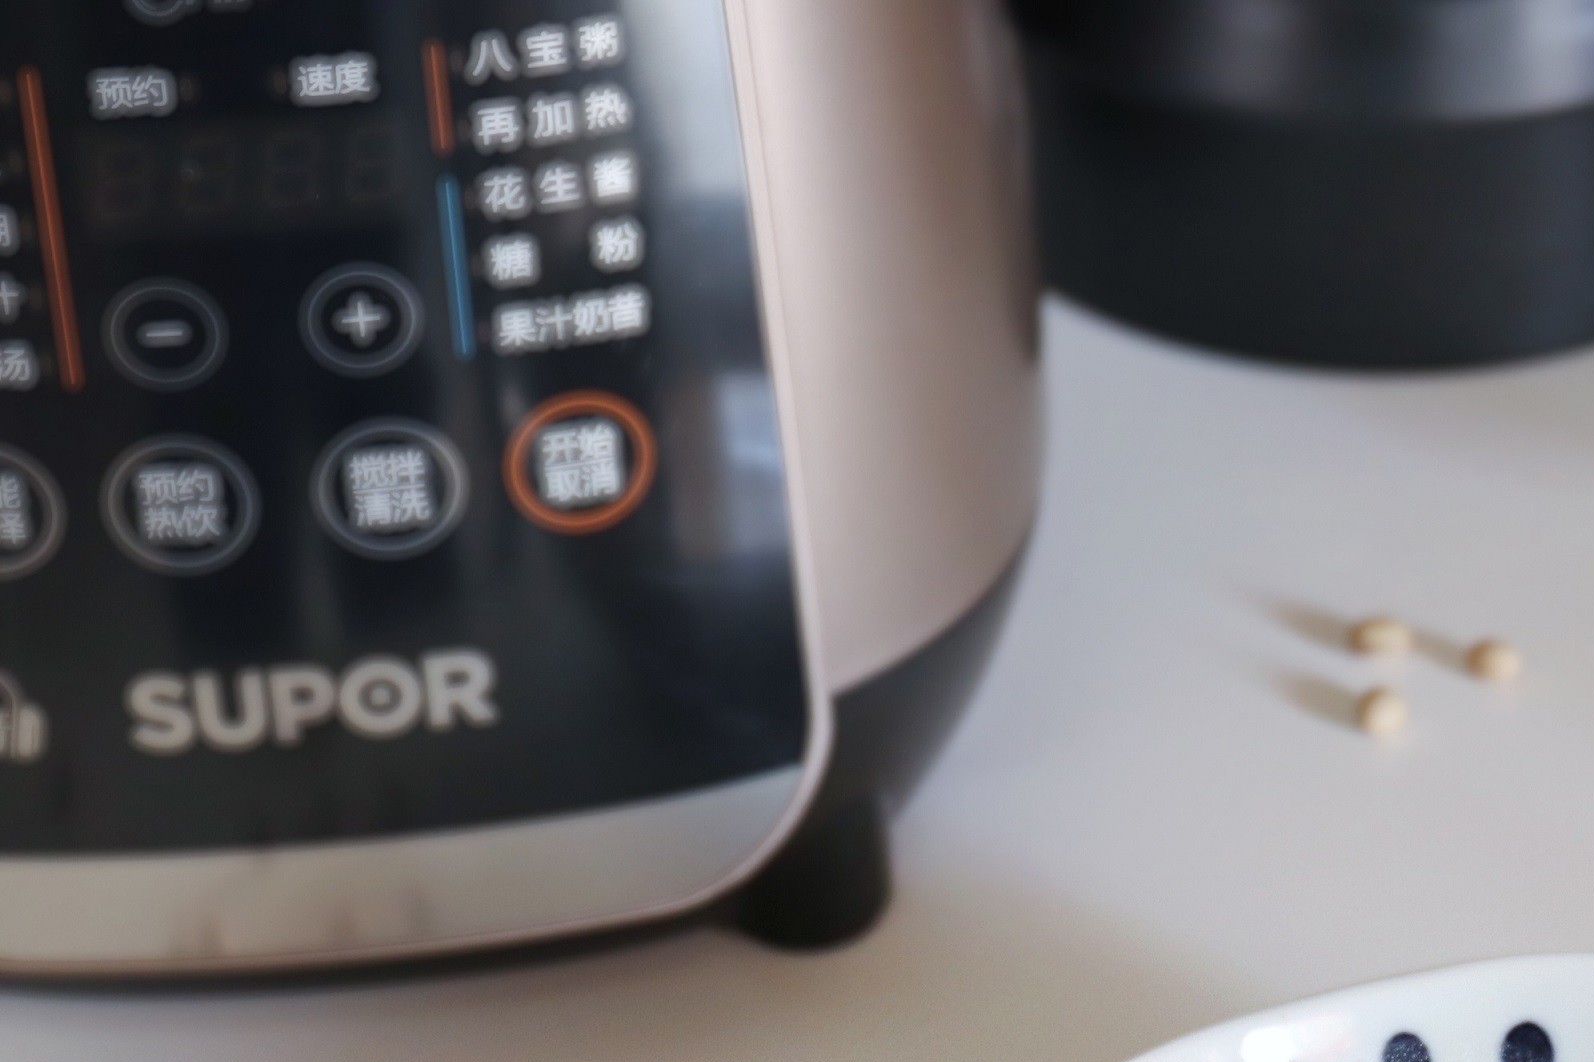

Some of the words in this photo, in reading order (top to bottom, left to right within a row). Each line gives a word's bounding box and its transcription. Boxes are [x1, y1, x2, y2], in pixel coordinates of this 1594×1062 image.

[470, 20, 621, 78] 八宝粥
[95, 72, 170, 111] 预约
[297, 58, 373, 98] 速度
[475, 87, 630, 147] 再加热
[482, 156, 633, 214] 花生酱
[498, 290, 645, 347] 果汁奶昔
[138, 468, 217, 506] 预约
[355, 488, 431, 528] 清洗
[144, 503, 221, 541] 热饮
[128, 650, 498, 754] SUPOR
